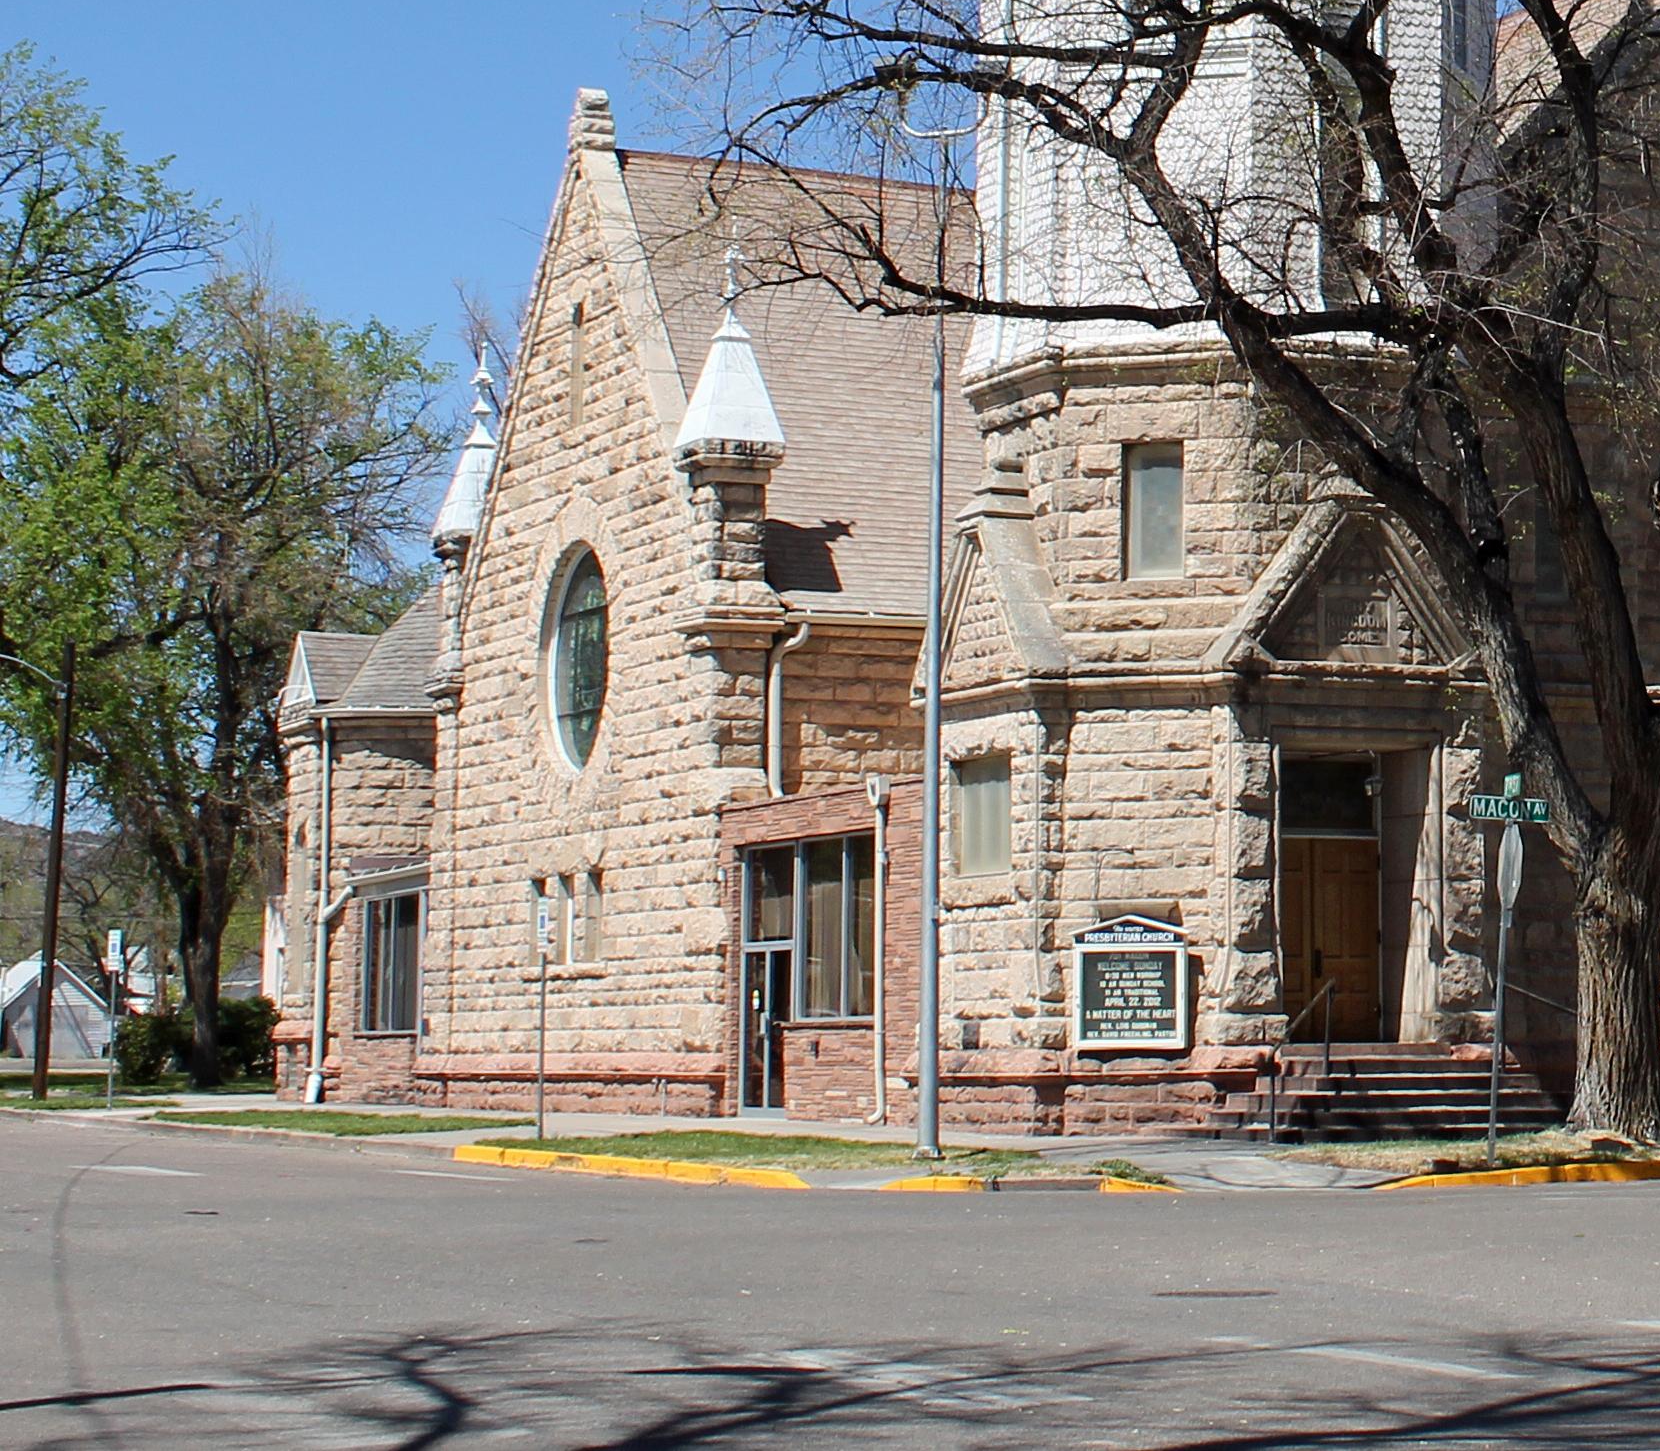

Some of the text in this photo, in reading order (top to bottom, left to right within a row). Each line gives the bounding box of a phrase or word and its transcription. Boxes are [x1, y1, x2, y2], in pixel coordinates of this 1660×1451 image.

[1474, 798, 1548, 819] MACON AV
[1085, 933, 1174, 942] PRESBYTERIAN CHURCH
[1134, 962, 1162, 970] SUNDAY
[1105, 997, 1126, 1007] APRIL
[1143, 997, 1162, 1007] 2012
[1086, 1009, 1176, 1020] A MATTER OF THE HEART
